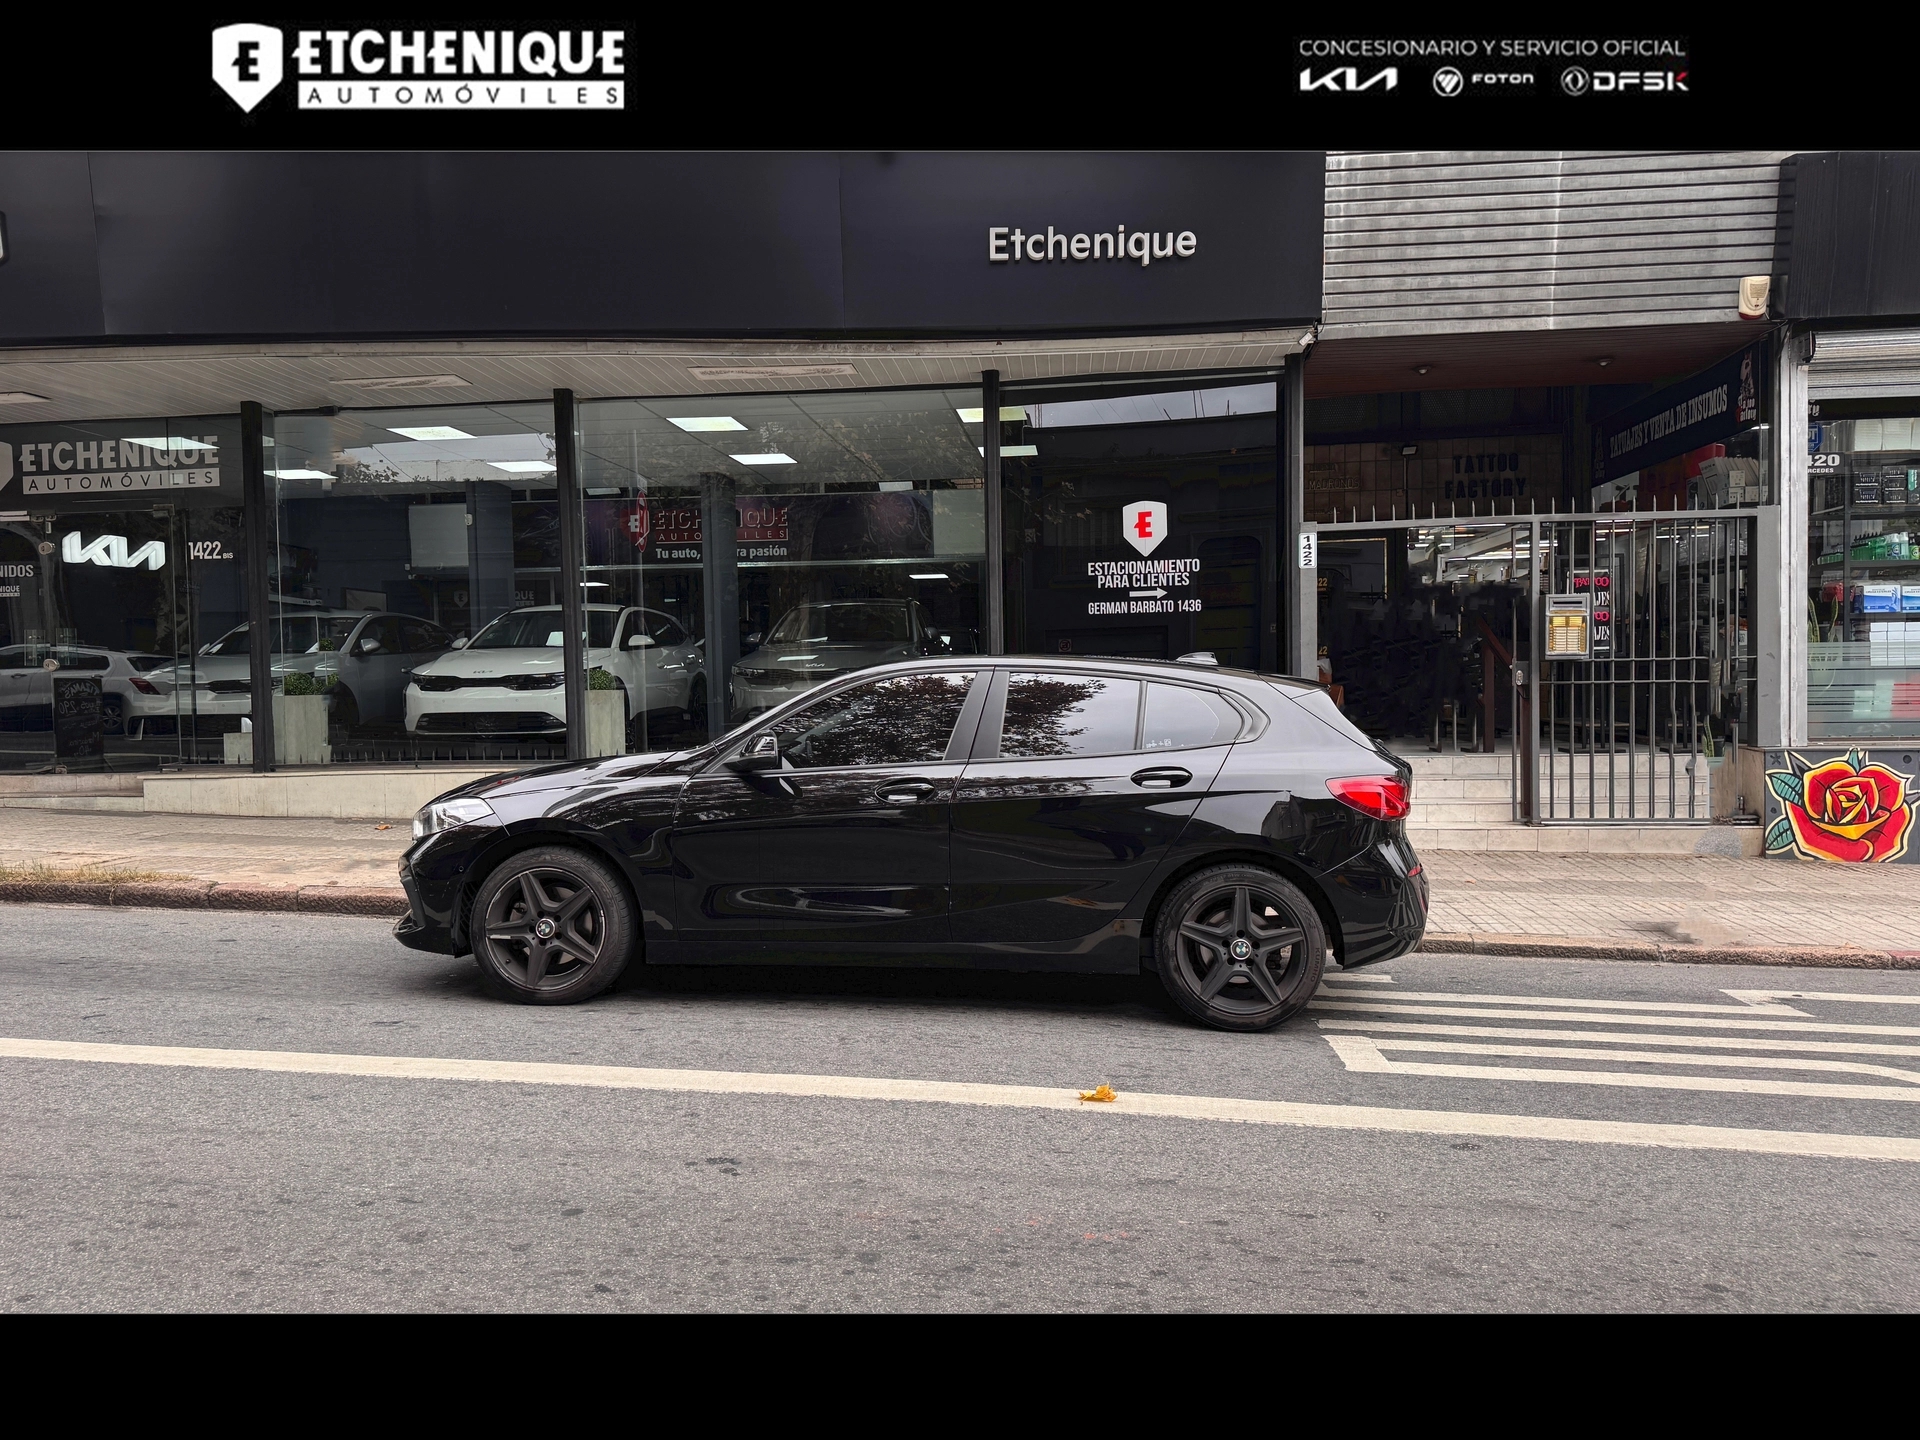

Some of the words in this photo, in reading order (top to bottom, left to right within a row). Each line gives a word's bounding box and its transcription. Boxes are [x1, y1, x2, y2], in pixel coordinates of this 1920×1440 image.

[989, 224, 1197, 267] Etchenique
[1609, 424, 1643, 459] TATUAJES
[1642, 424, 1650, 446] Y
[1650, 407, 1676, 441] VENTA
[1675, 402, 1687, 431] DE
[1688, 384, 1728, 425] INSUMOS
[18, 435, 219, 472] ETCHENIQUE
[1453, 453, 1519, 474] TATTOO
[28, 472, 213, 491] AUTOMÓVILES
[1445, 477, 1527, 499] FACTORY
[188, 541, 221, 560] 1422
[656, 549, 669, 559] Tu
[672, 549, 701, 560] auto,
[750, 545, 787, 559] pasión
[1302, 535, 1313, 566] 1422
[1088, 558, 1200, 576] ESTACIONAMIENTO
[1098, 574, 1129, 588] PARA
[1132, 572, 1190, 587] CLIENTES
[1088, 600, 1128, 615] GERMAN
[1130, 600, 1174, 614] BARBATO
[1177, 599, 1202, 612] 1436
